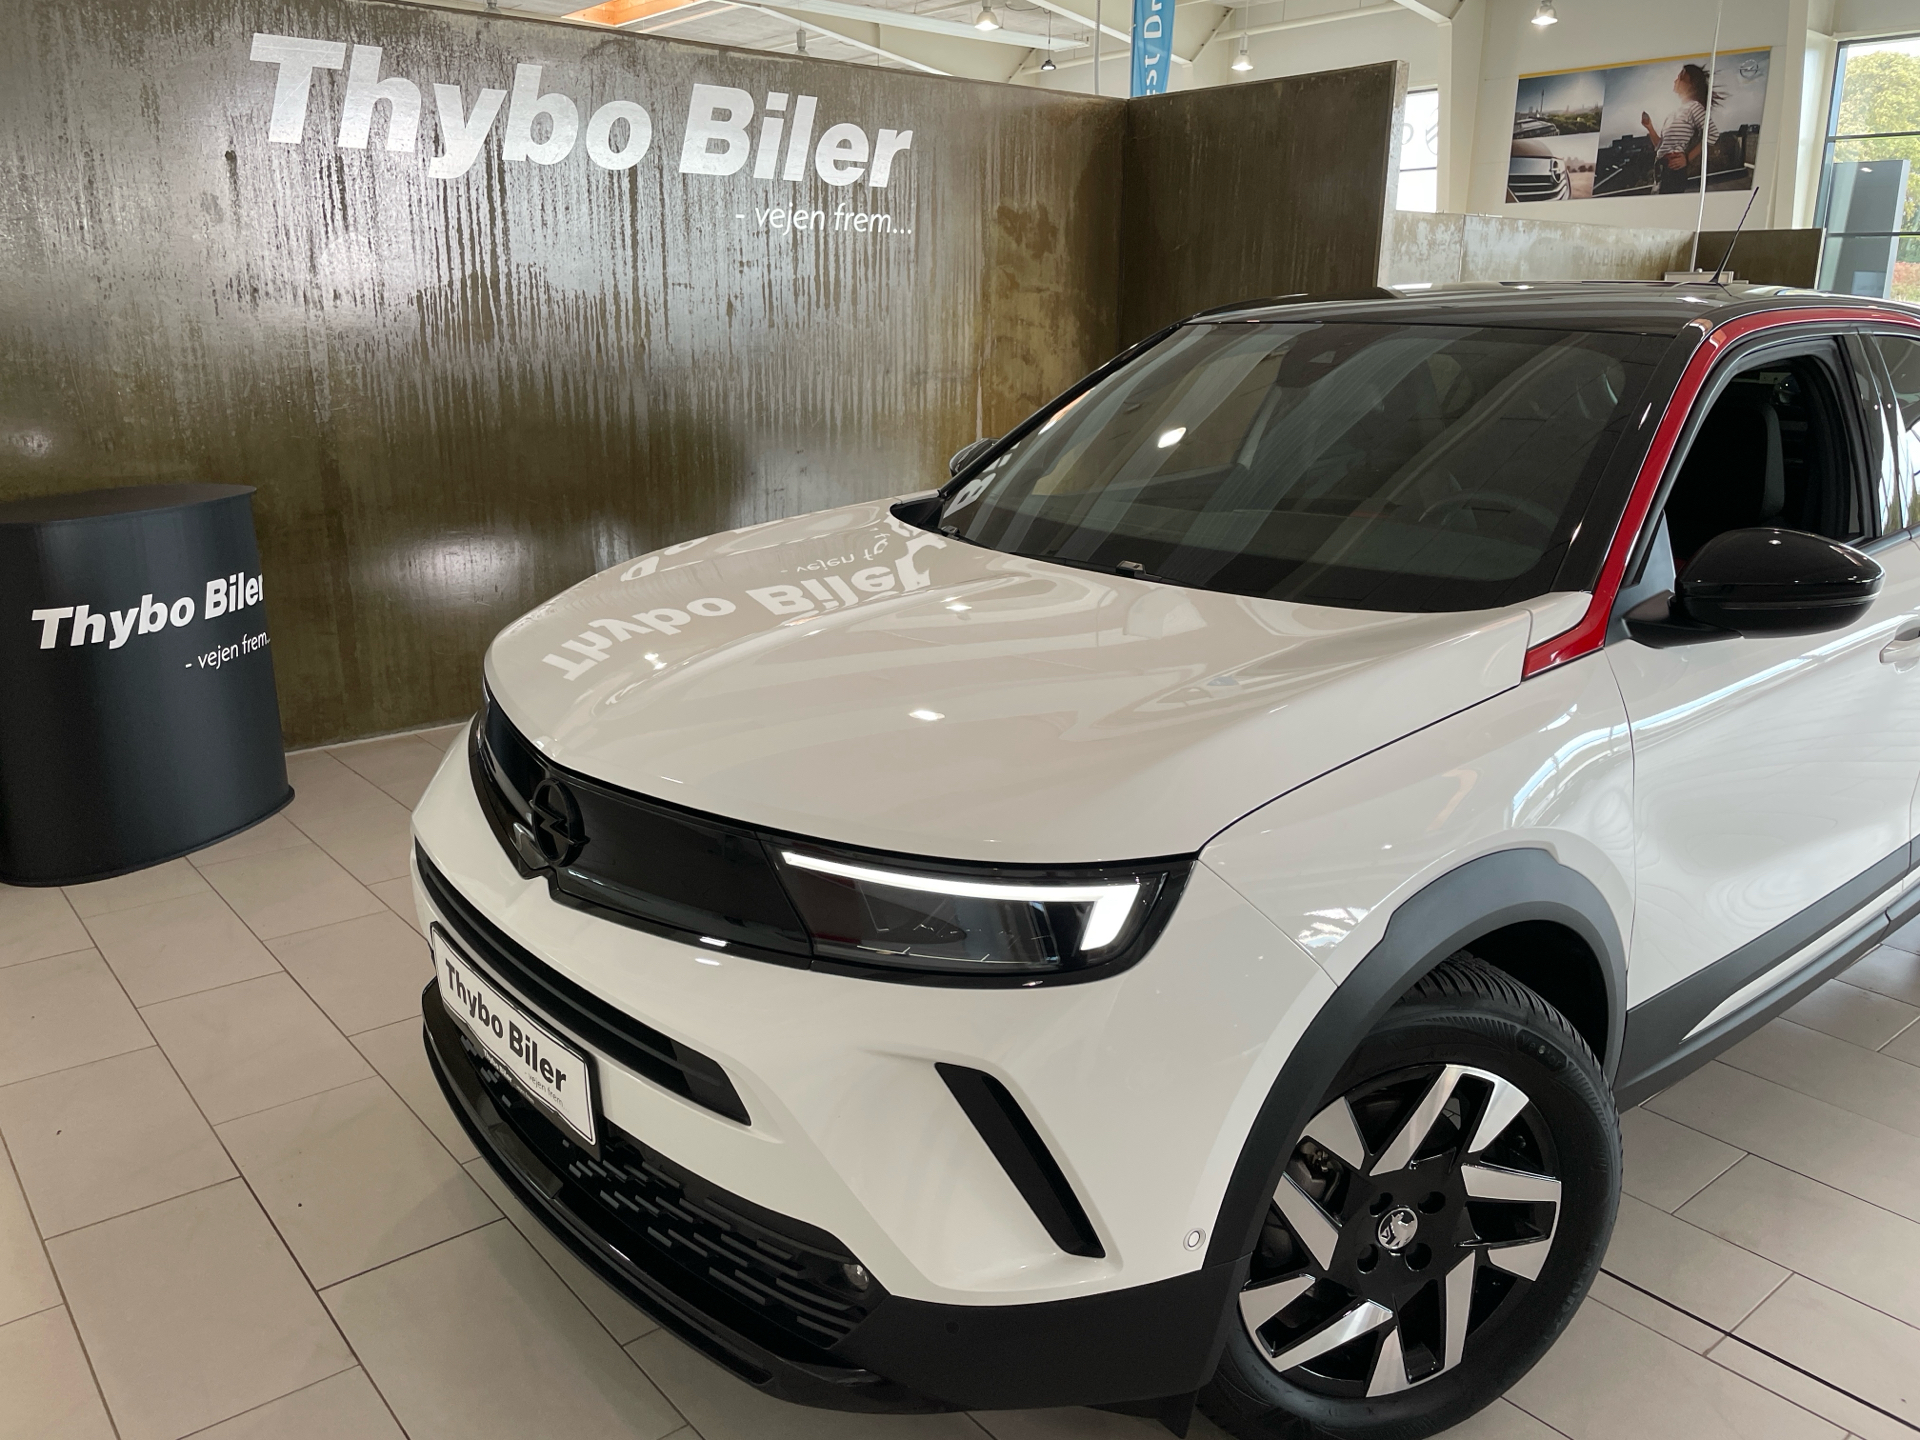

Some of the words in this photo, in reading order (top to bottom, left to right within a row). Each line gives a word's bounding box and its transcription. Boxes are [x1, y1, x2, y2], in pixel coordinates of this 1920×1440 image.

[250, 33, 652, 179] Thybo
[679, 83, 912, 188] Biler
[755, 202, 826, 236] vejen
[834, 202, 912, 234] frem...
[31, 594, 195, 650] Thybo
[204, 571, 264, 620] Biler
[197, 644, 239, 670] vejen
[445, 958, 504, 1039] Thybo
[508, 1019, 567, 1093] Biler
